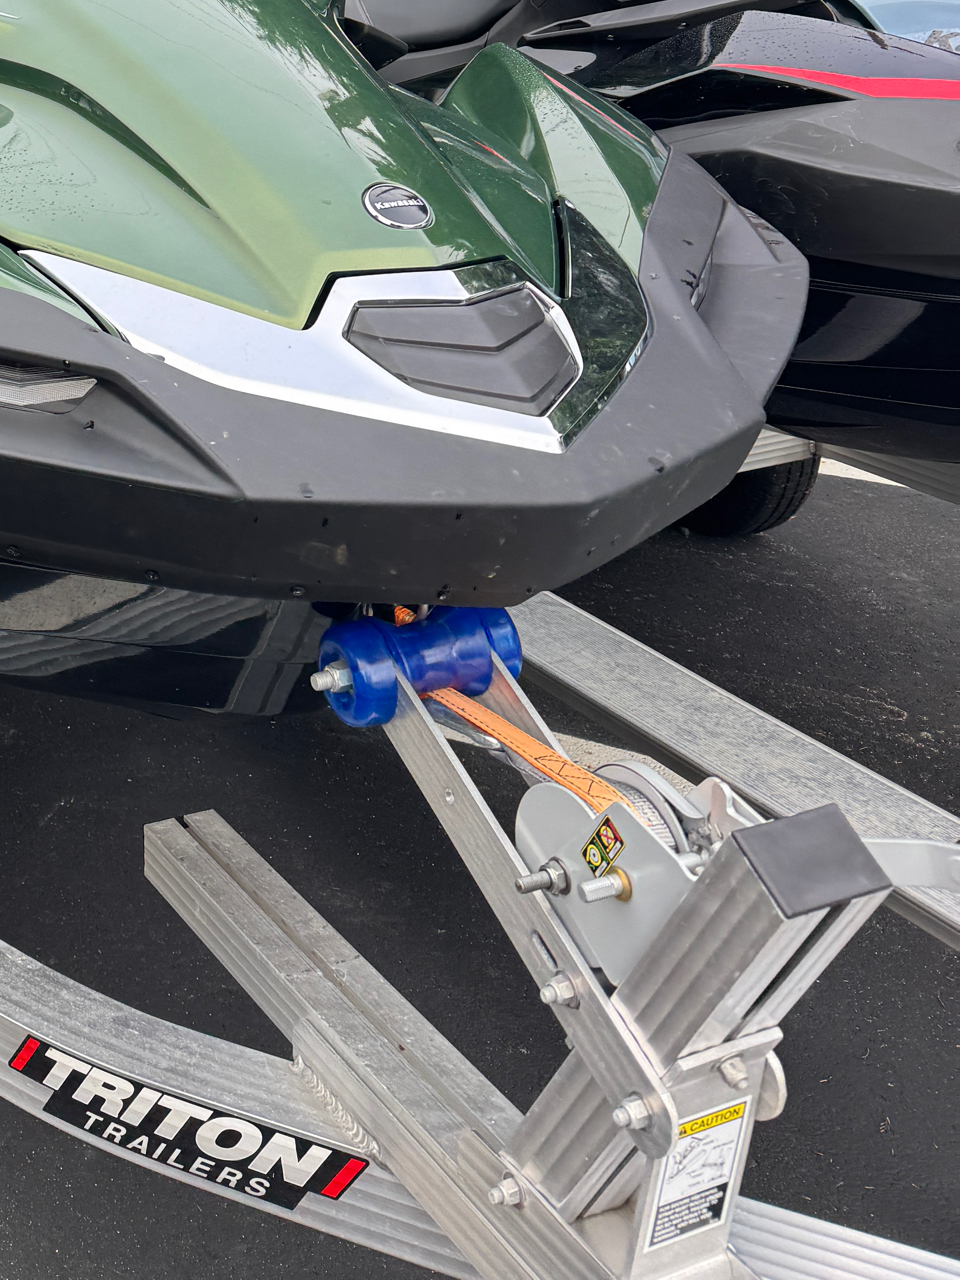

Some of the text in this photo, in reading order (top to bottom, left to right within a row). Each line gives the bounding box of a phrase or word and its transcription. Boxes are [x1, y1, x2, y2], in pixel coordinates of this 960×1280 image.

[374, 198, 424, 210] Kawasaki
[42, 1046, 332, 1188] TRITON
[689, 1107, 741, 1133] CAUTION
[83, 1111, 271, 1198] TRAILERS
